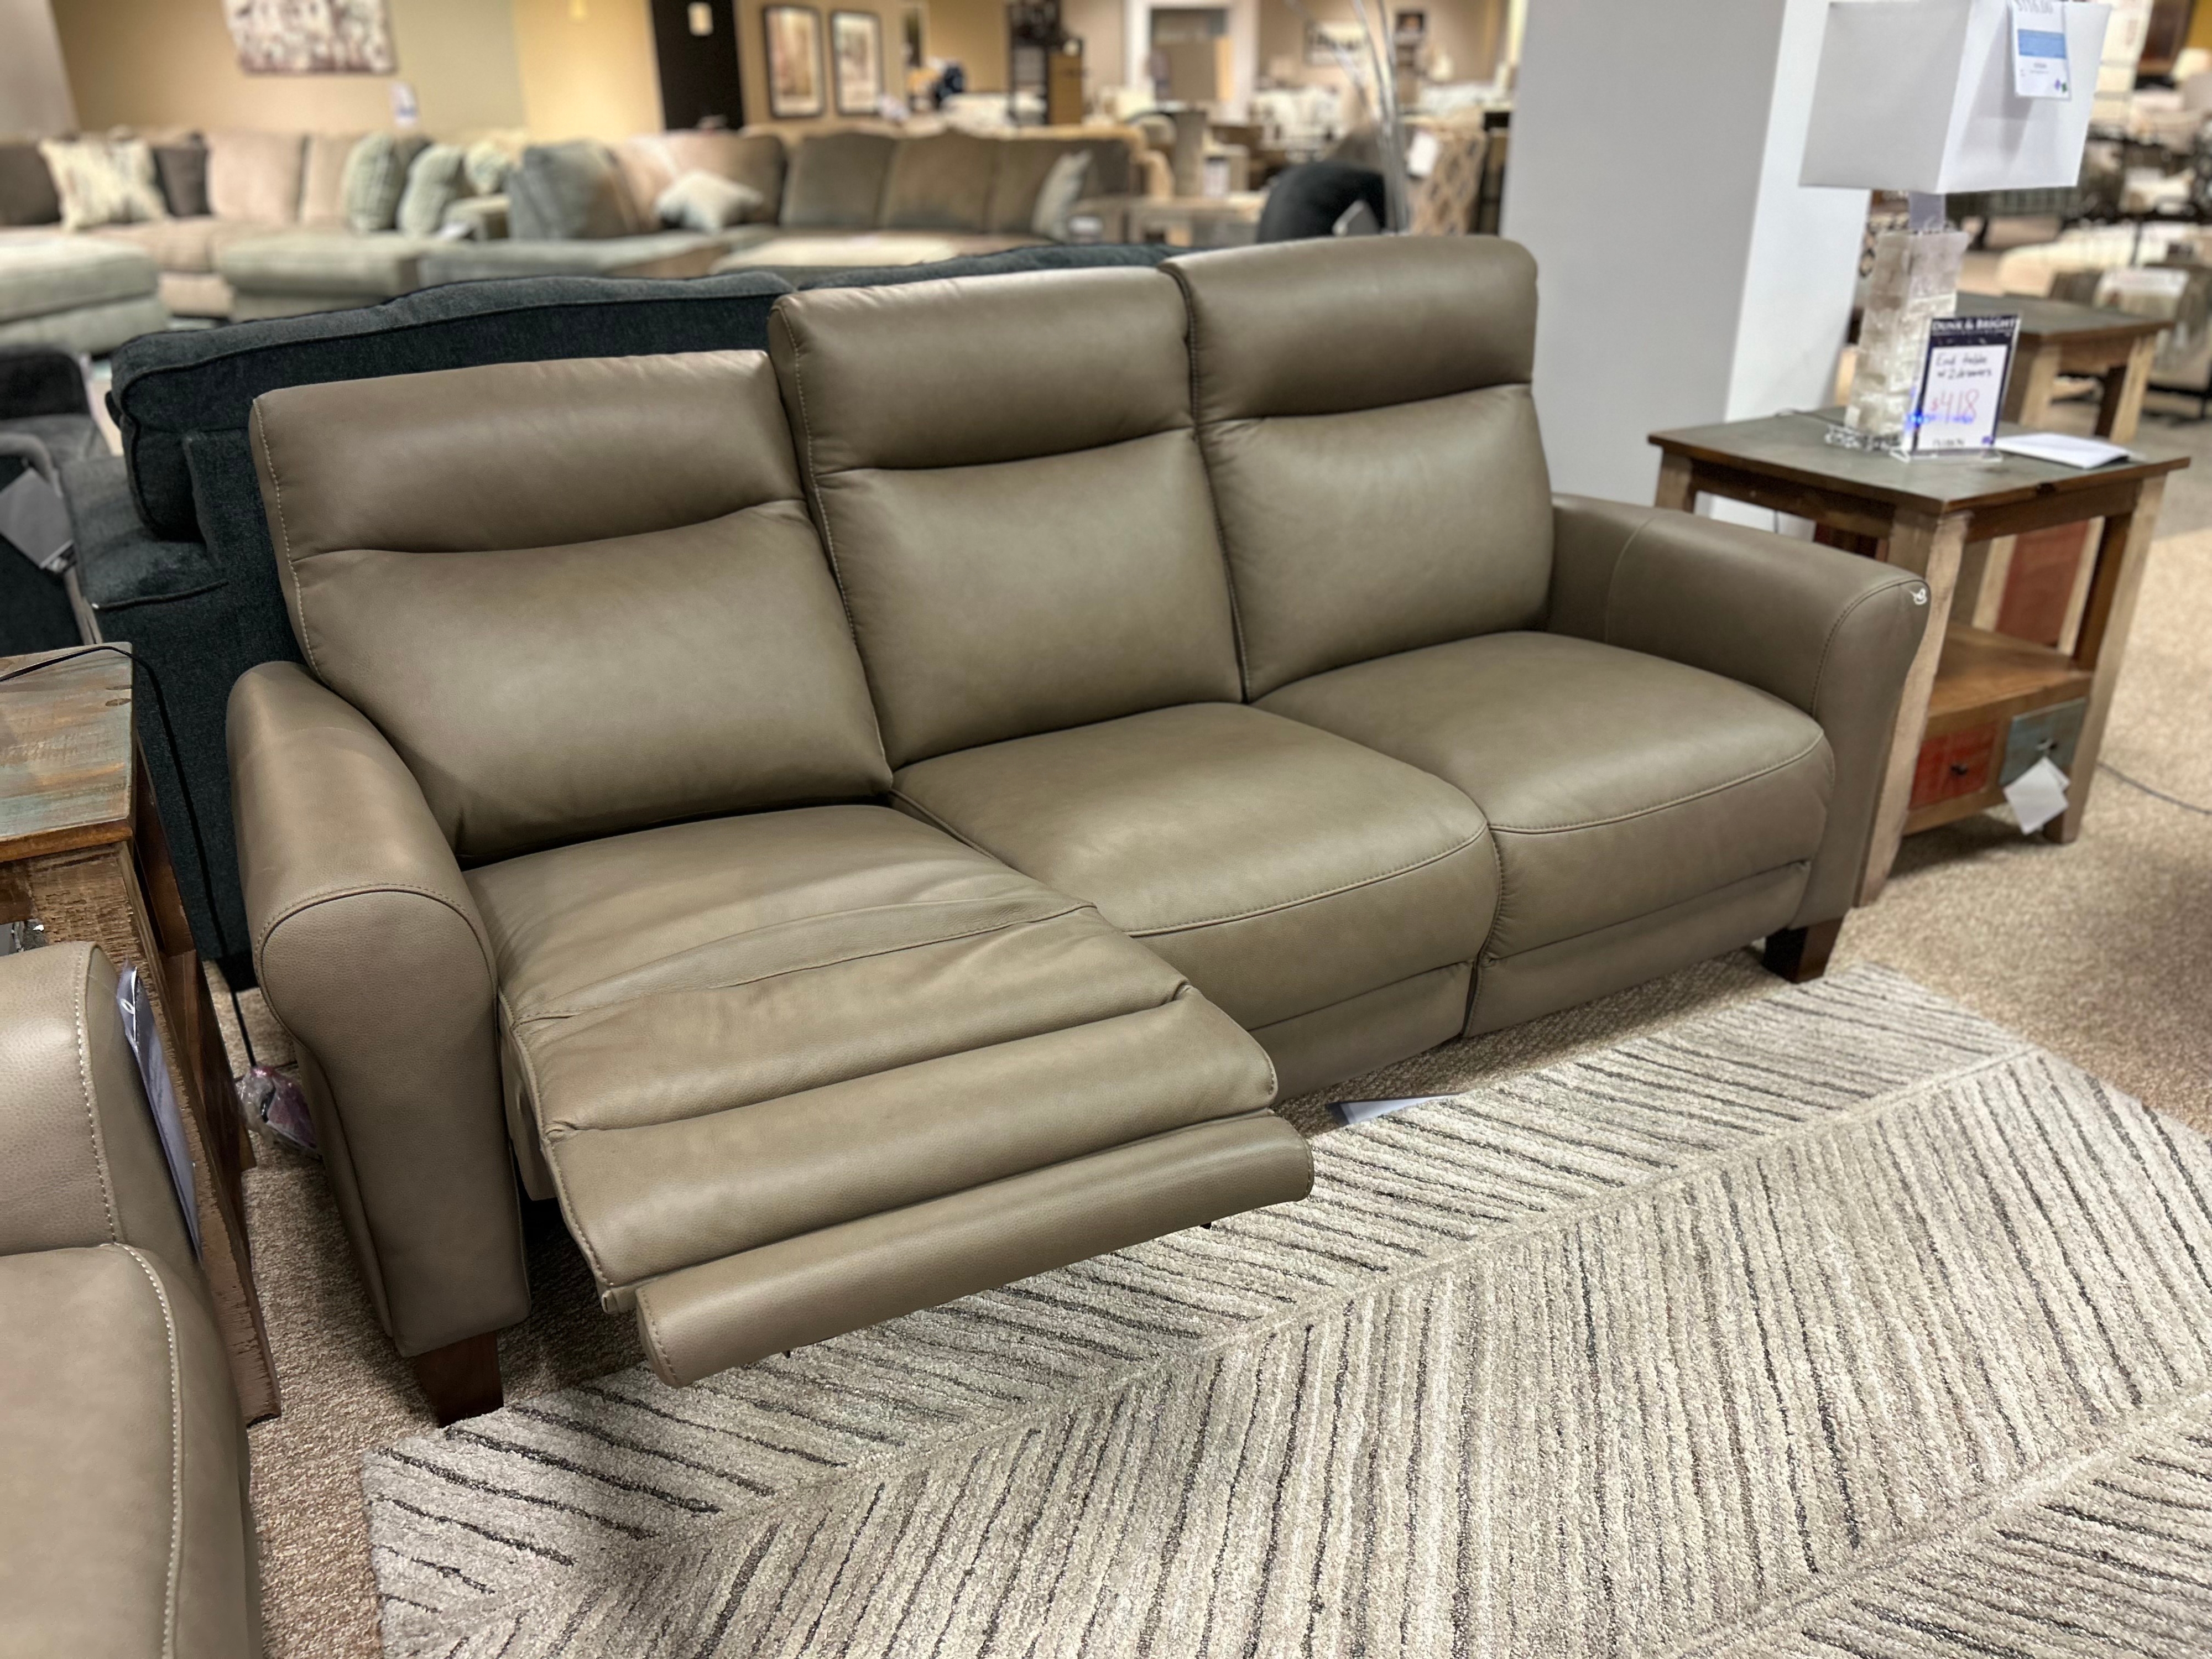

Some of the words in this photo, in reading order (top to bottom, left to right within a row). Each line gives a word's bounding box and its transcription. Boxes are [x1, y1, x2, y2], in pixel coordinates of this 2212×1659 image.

[1933, 320, 1963, 331] DUNK
[1965, 318, 1974, 330] &
[1976, 317, 2016, 330] BRIGHT
[1936, 352, 1956, 366] End
[1931, 388, 1980, 424] $418
